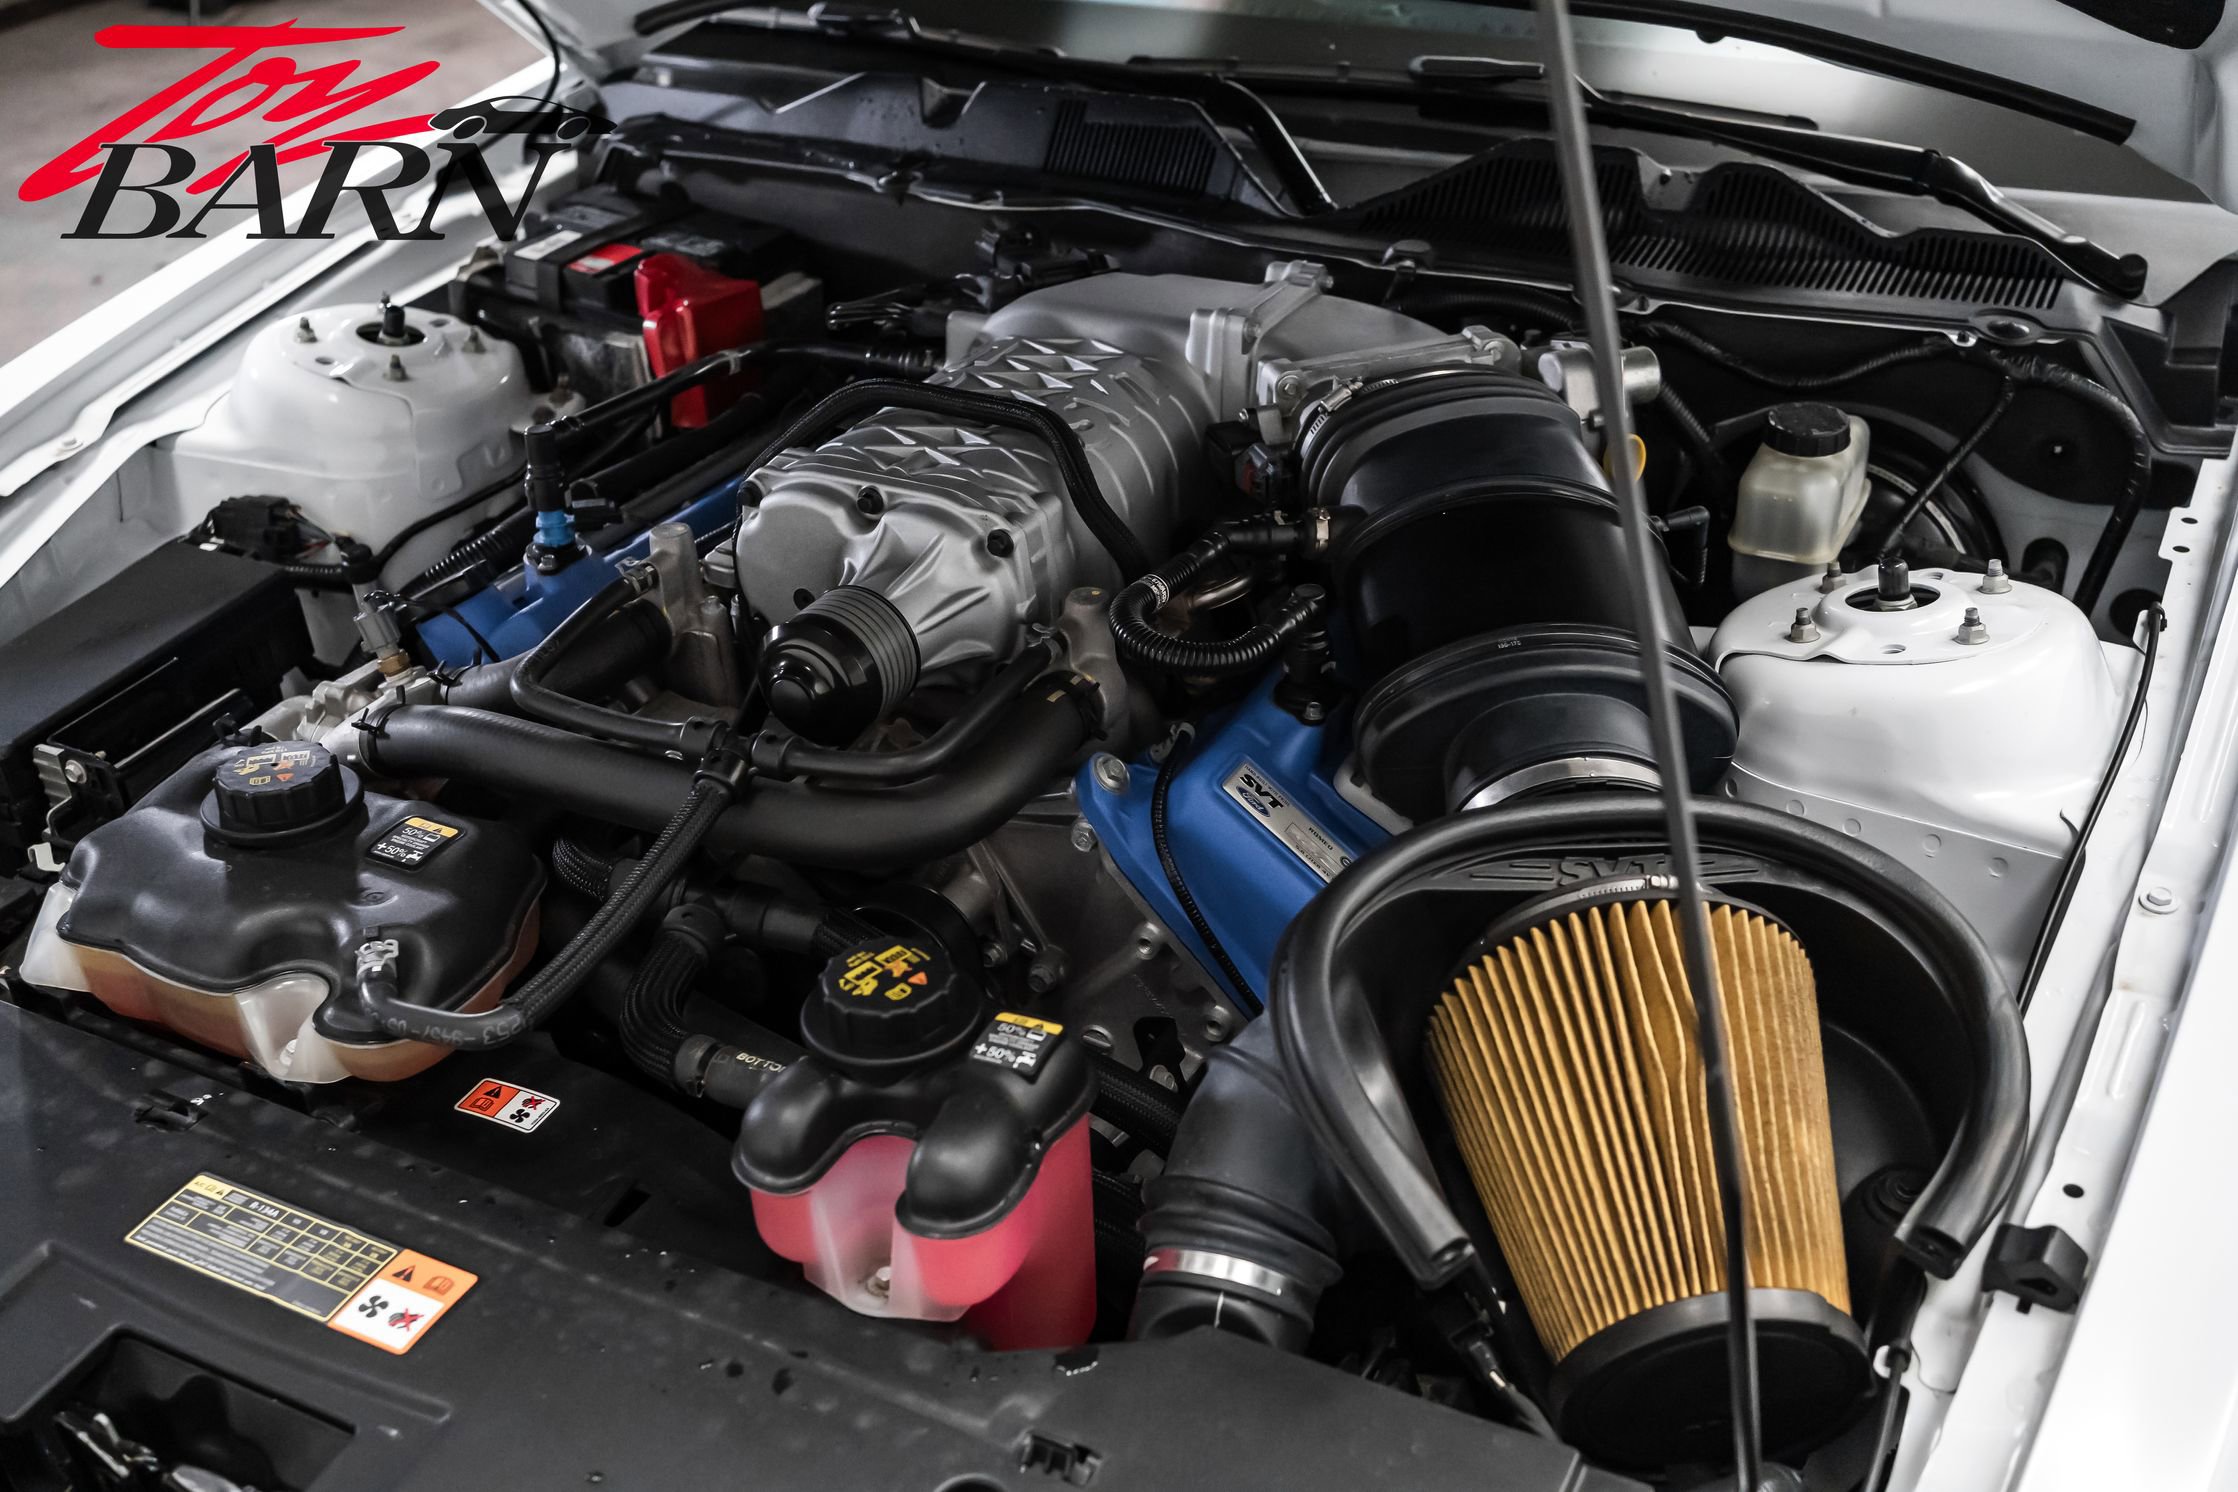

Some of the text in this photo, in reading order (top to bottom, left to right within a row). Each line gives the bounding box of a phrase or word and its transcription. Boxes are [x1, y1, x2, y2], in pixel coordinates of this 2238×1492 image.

[1239, 773, 1284, 809] SVT
[402, 826, 424, 839] 50%
[1308, 827, 1334, 851] ROMEO
[248, 1200, 281, 1219] R-134A
